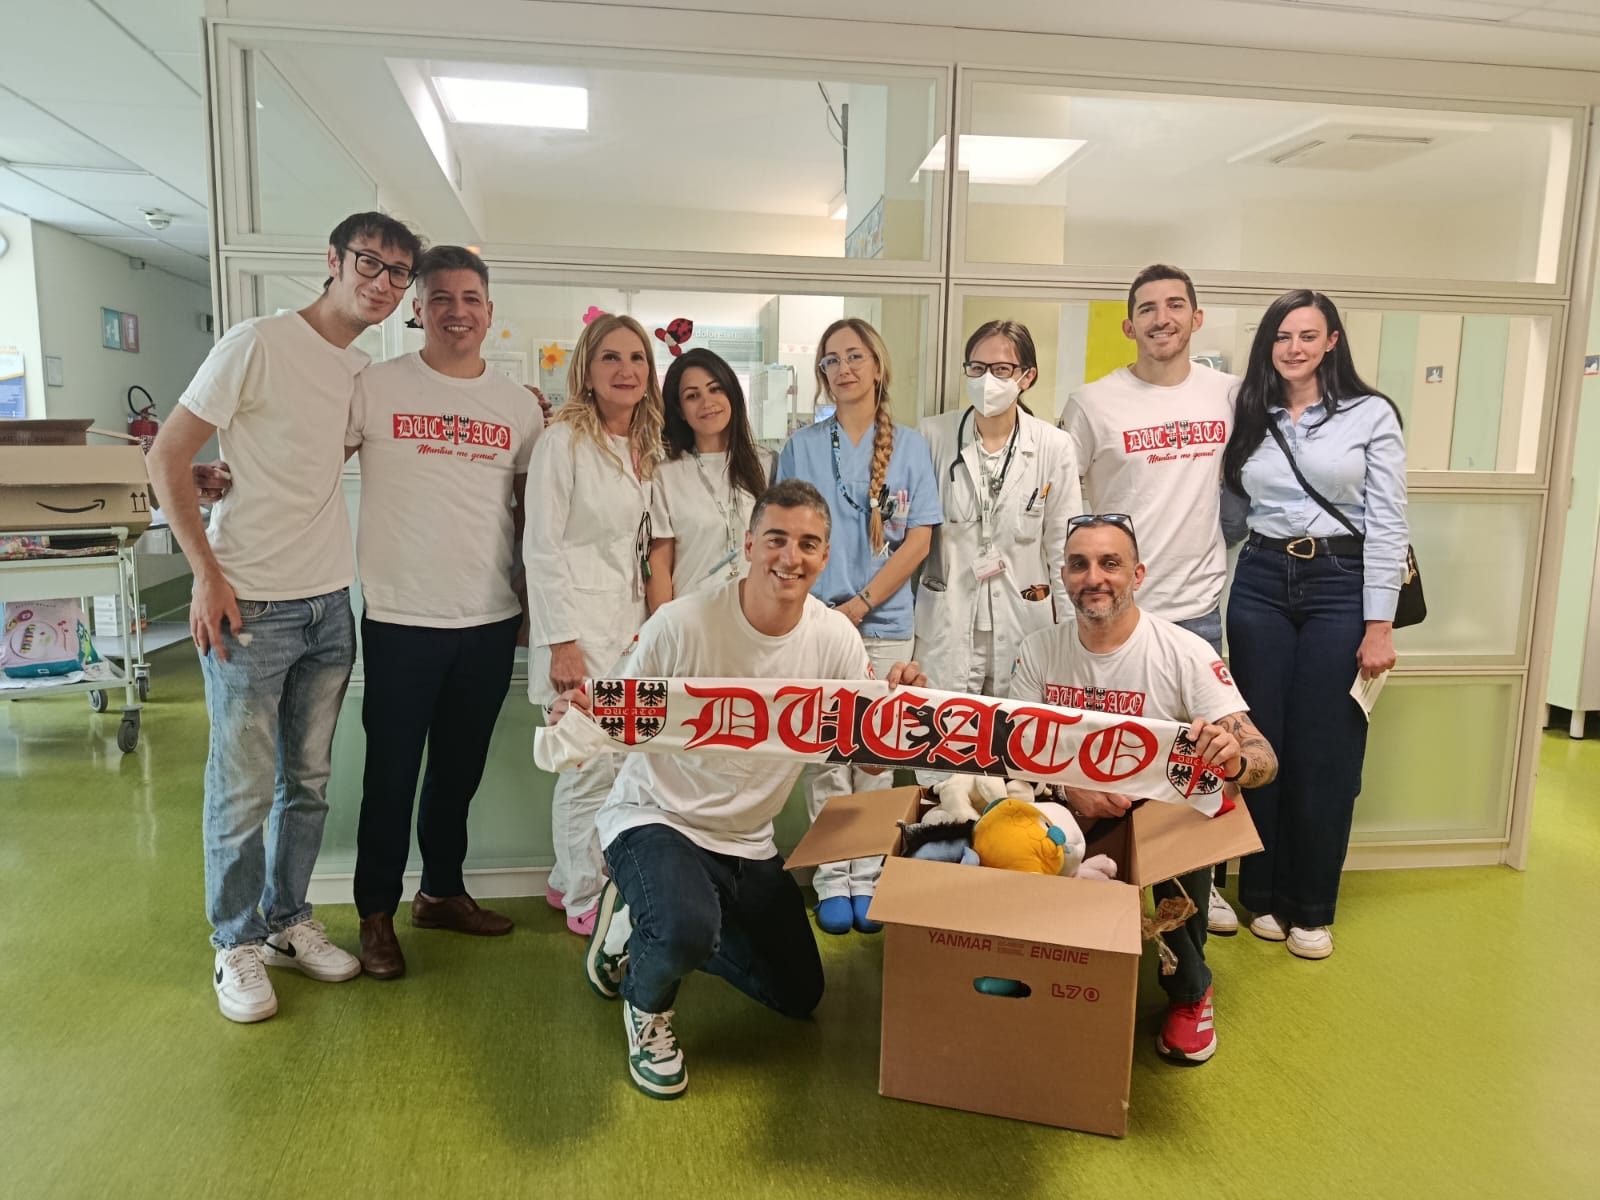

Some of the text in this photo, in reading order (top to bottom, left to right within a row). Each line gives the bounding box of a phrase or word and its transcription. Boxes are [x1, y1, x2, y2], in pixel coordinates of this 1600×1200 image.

[416, 444, 453, 455] Mantua
[470, 452, 498, 461] genuit
[603, 708, 657, 716] DUCATO
[682, 683, 1160, 783] DUCATO
[928, 930, 992, 952] YANMAR
[1030, 946, 1090, 965] ENGINE
[1051, 983, 1100, 1002] L70
